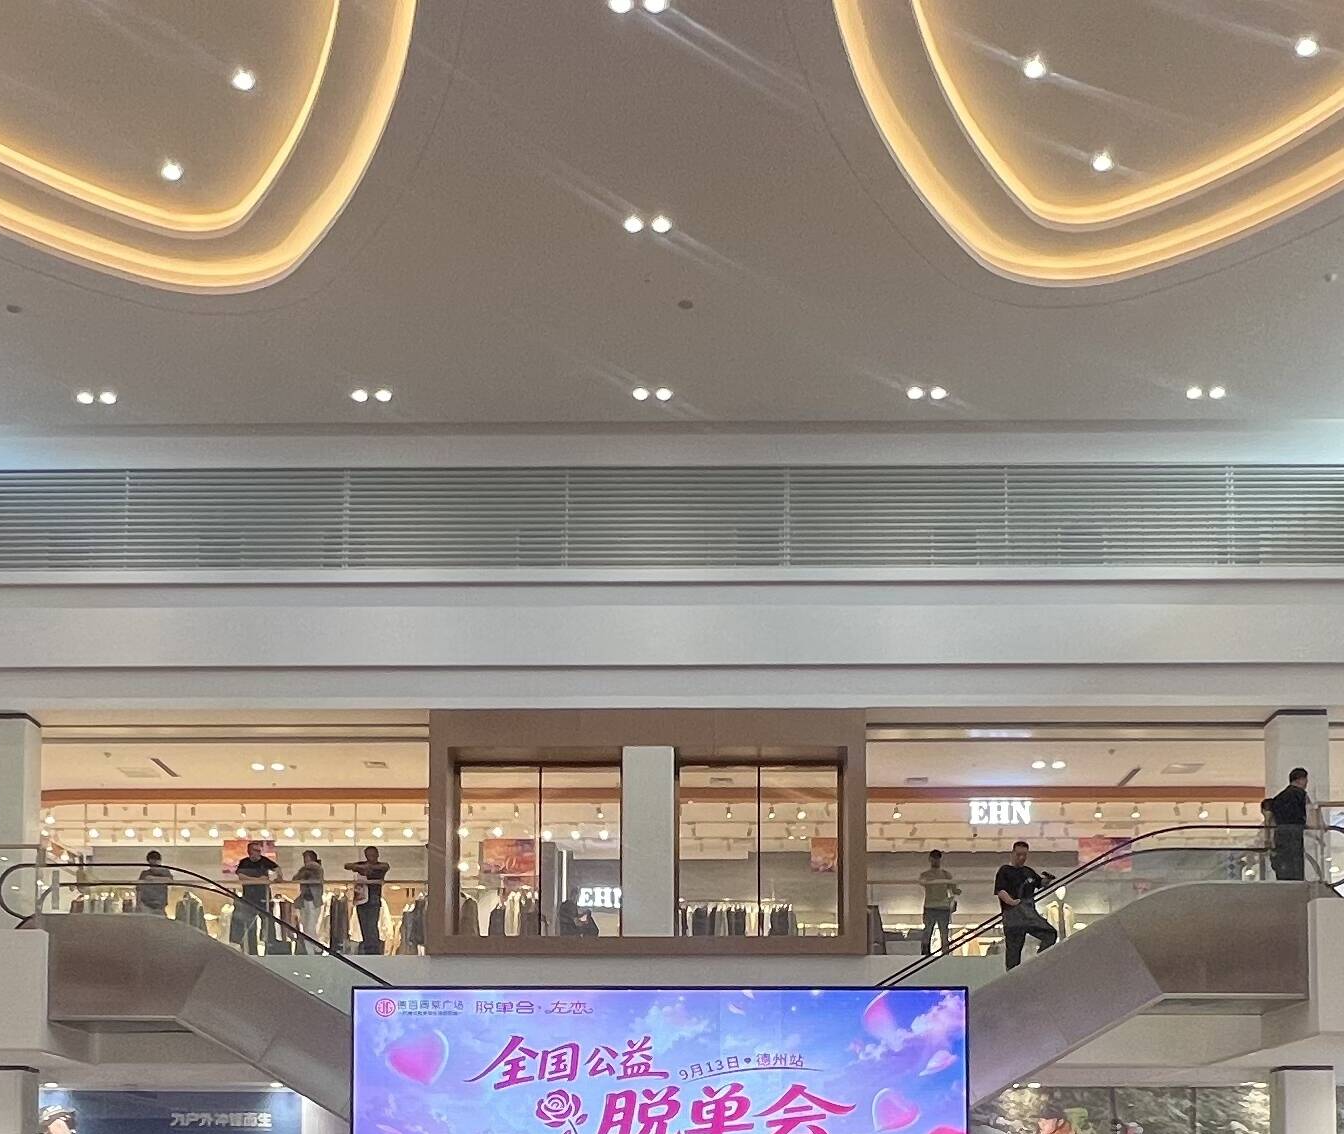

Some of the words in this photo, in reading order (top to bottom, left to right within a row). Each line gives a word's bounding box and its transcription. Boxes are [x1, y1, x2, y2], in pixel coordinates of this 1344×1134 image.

[969, 800, 1032, 825] EHN
[463, 1035, 670, 1090] 全国公益
[679, 1056, 739, 1080] 9月13日
[756, 1052, 805, 1068] 德州站
